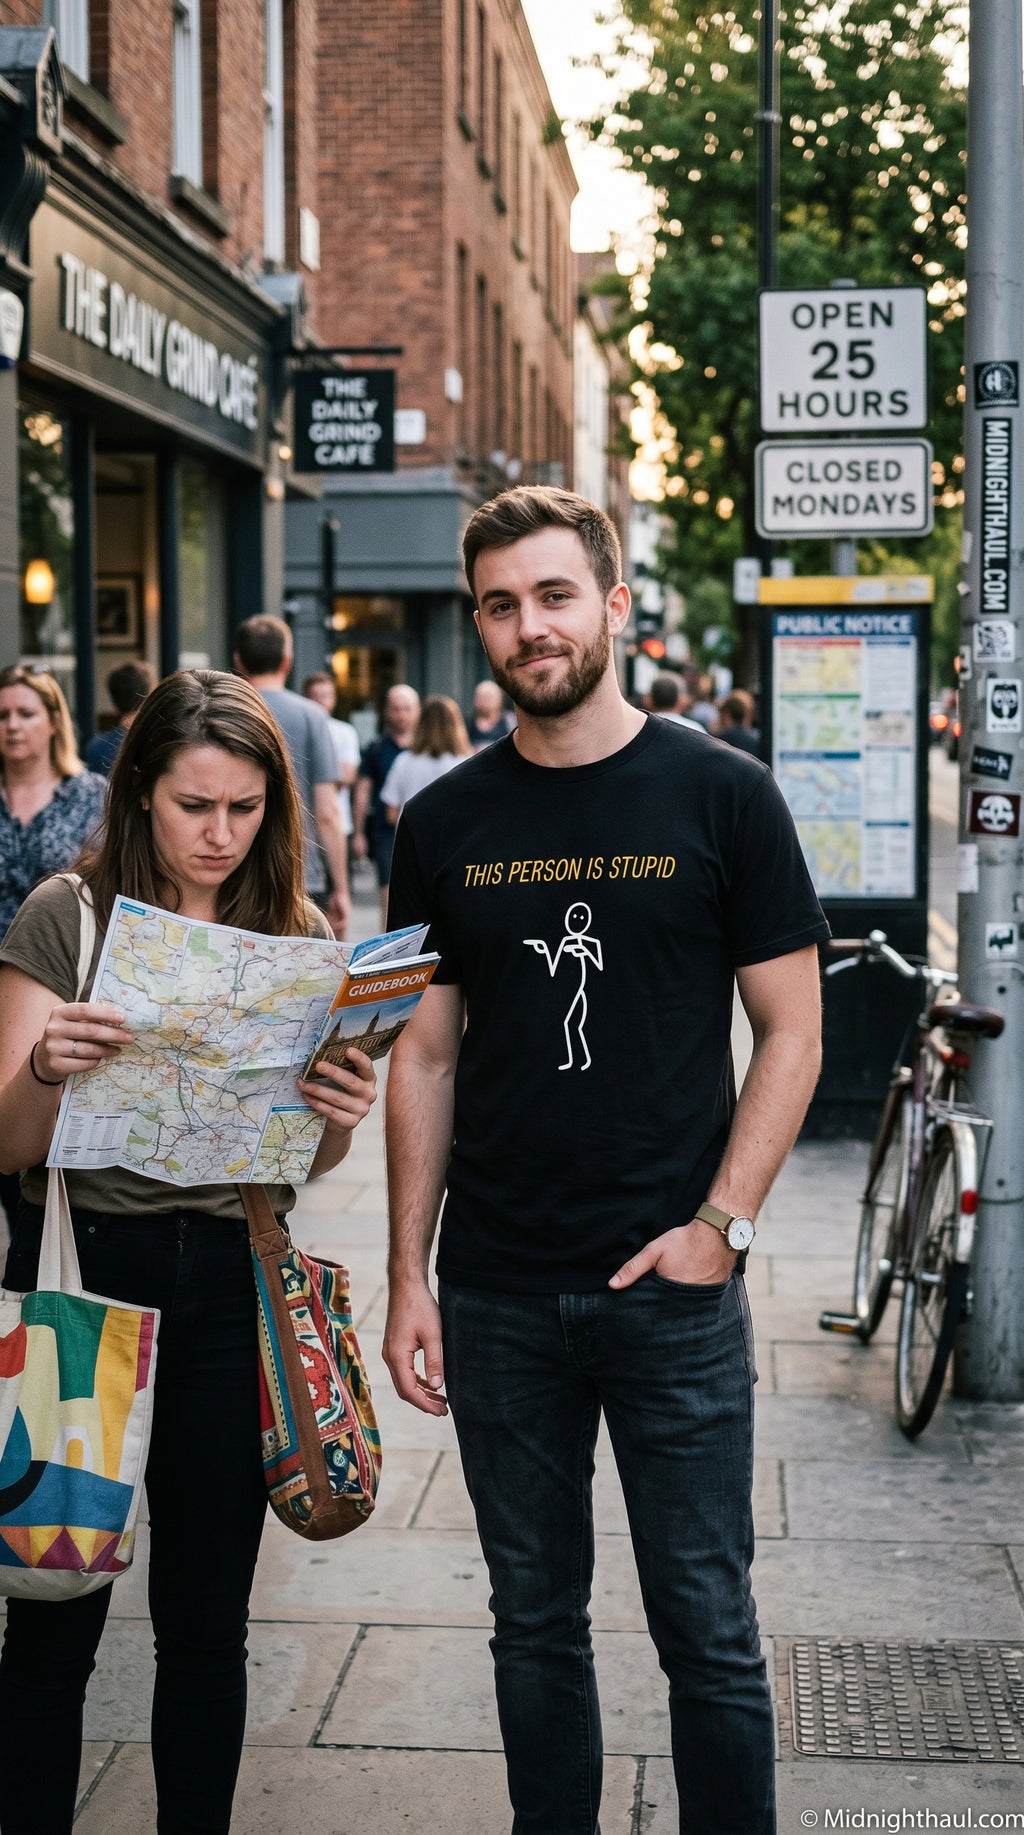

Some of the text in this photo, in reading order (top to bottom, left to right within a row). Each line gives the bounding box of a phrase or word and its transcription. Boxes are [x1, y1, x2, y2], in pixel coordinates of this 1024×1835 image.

[792, 301, 893, 329] OPEN
[62, 251, 259, 431] THE DAILY GRIND CAFÉ
[811, 340, 876, 380] 25
[321, 376, 368, 399] THE
[311, 400, 378, 420] DAILY
[779, 390, 909, 418] HOURS
[308, 421, 382, 443] GRIND
[786, 460, 903, 483] CLOSED
[772, 493, 917, 516] MONDAYS
[983, 421, 1009, 610] MIDNIGHTHAUL.COM
[777, 615, 912, 634] PUBLIC NOTICE
[465, 856, 676, 887] THIS PERSON IS STUPID
[348, 971, 429, 997] GUIDEBOOK
